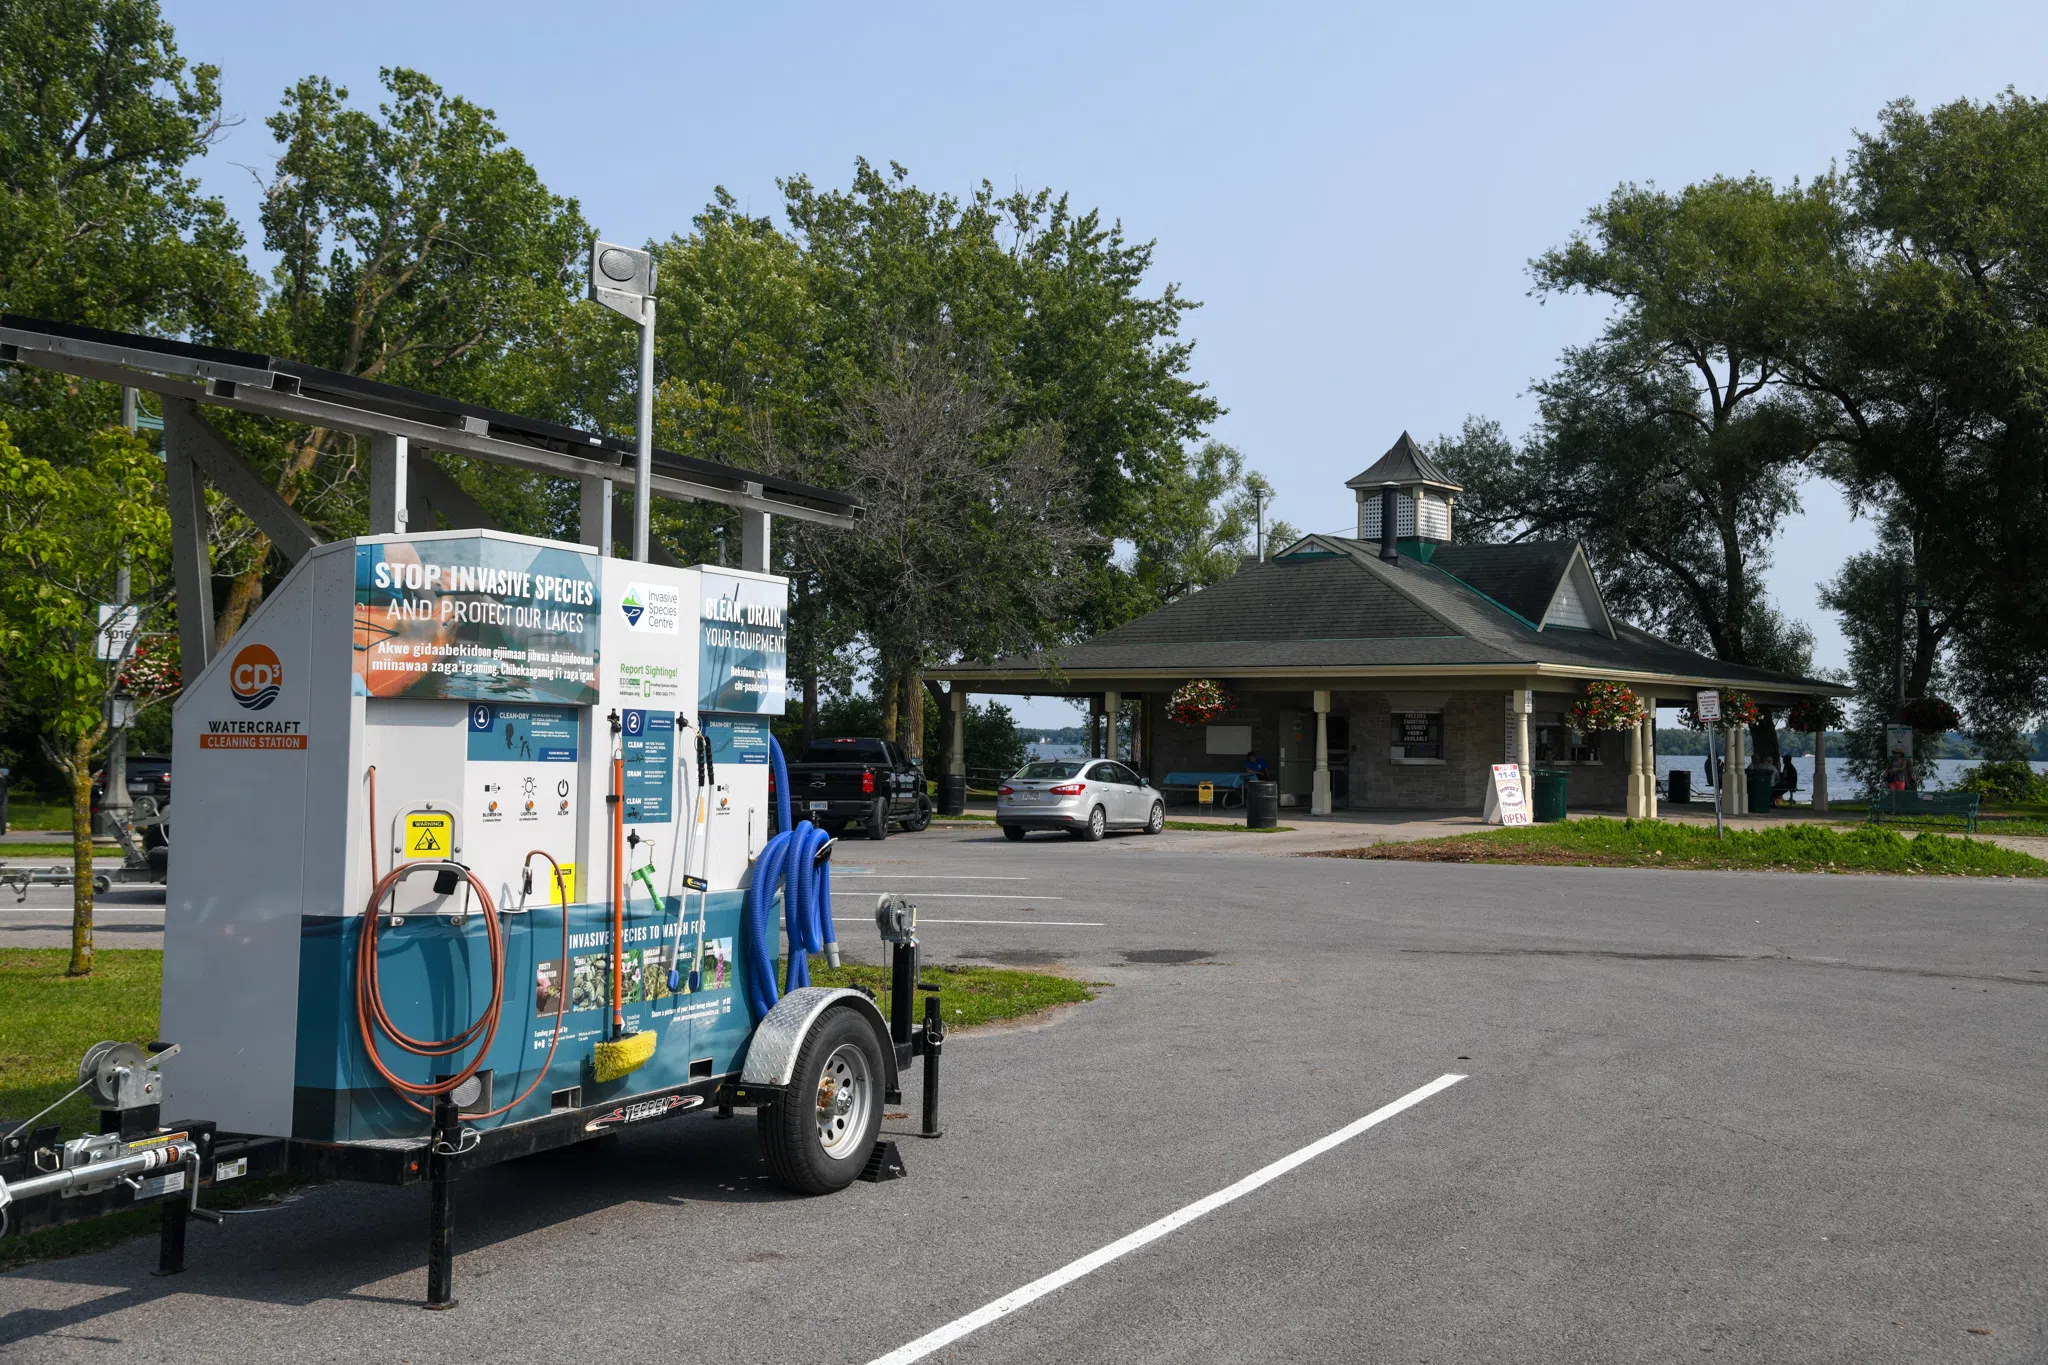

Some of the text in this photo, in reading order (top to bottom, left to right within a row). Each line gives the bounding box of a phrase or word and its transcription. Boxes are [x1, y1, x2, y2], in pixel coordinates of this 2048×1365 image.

[374, 562, 594, 606] STOP INVASIVE SPECIES
[648, 590, 678, 604] Invasive
[386, 598, 584, 634] AND PROTECT OUR LAKES
[648, 603, 677, 618] Species
[706, 598, 784, 632] CLEAN, DRAIN,
[648, 616, 674, 629] Centre
[706, 627, 786, 653] YOUR EQUIPMENT
[378, 642, 410, 654] Akwe
[413, 643, 492, 658] gidaabekidoon
[527, 648, 550, 662] jibwaa
[372, 659, 428, 672] miinawaa
[501, 663, 554, 680] Chibekaagamig
[620, 664, 678, 679] Report Sightings!
[478, 710, 485, 723] 1
[630, 716, 637, 728] 2
[208, 721, 300, 733] WATERCRAFT
[208, 737, 300, 748] CLEANING STATION
[1504, 812, 1527, 824] OPEN
[569, 930, 609, 949] INVASIVE
[650, 925, 660, 939] TO
[662, 922, 688, 938] WATH
